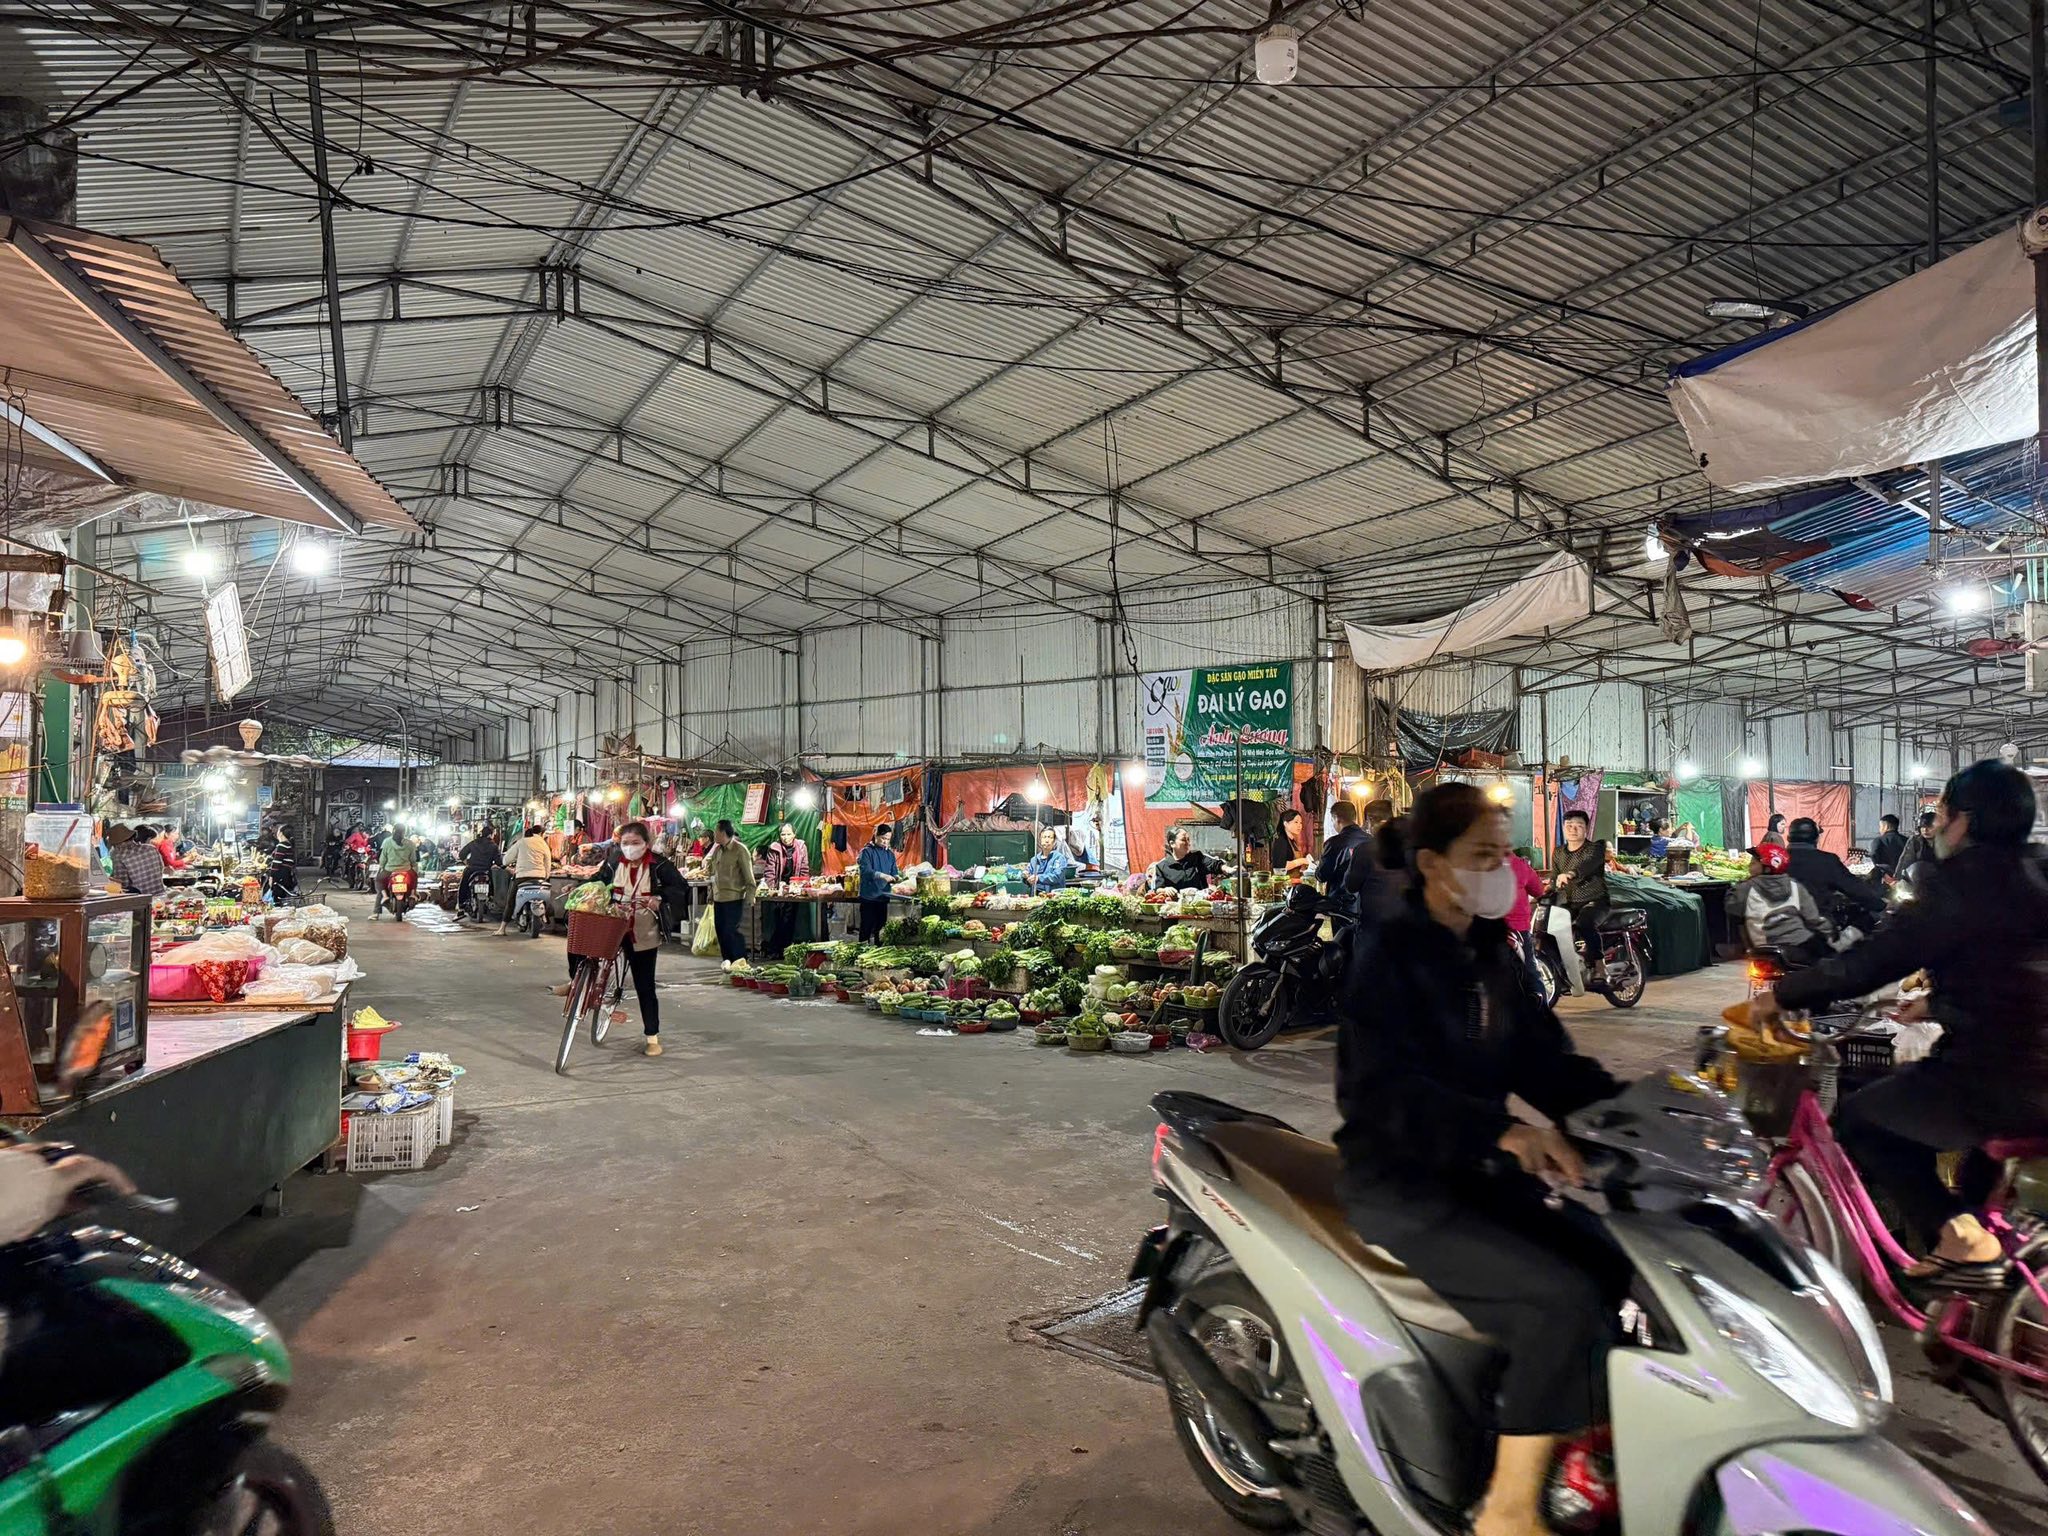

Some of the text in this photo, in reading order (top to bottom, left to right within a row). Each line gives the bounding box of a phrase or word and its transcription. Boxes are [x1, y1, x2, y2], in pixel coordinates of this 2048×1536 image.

[1233, 671, 1246, 683] GẠO
[1265, 666, 1278, 679] TÂY
[1197, 686, 1287, 719] ĐẠI LÝ GẠO
